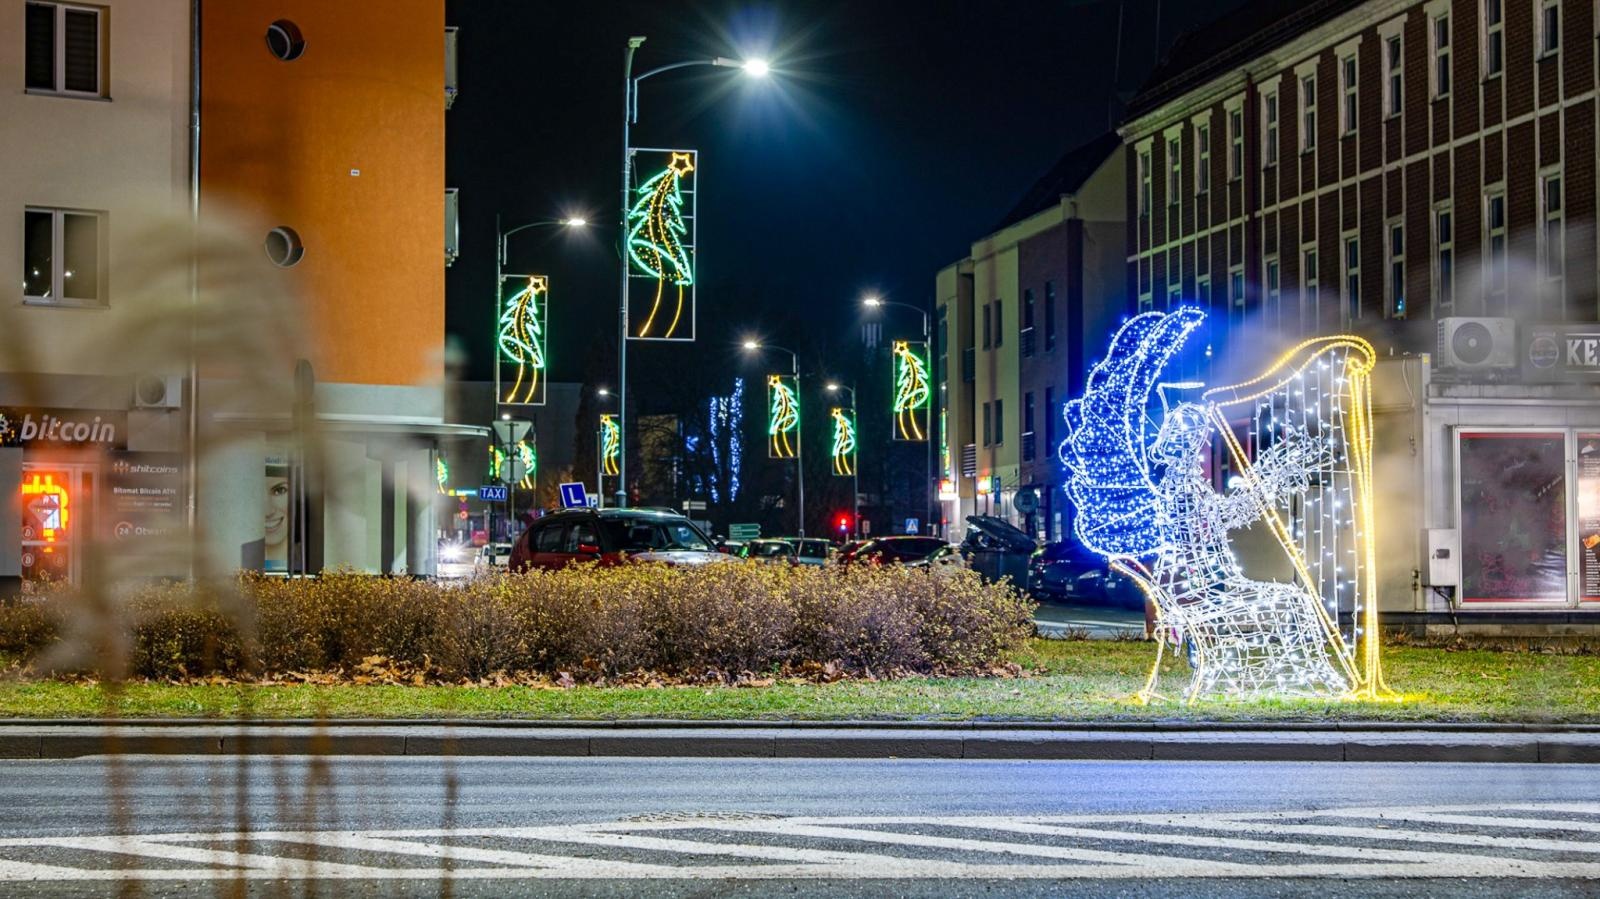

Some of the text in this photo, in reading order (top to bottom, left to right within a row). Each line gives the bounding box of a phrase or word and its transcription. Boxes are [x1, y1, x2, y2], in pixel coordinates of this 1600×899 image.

[1567, 339, 1600, 366] KE
[20, 414, 115, 442] bitcoin
[130, 465, 178, 473] shitcoins
[481, 487, 506, 499] TAXI
[568, 487, 582, 504] L
